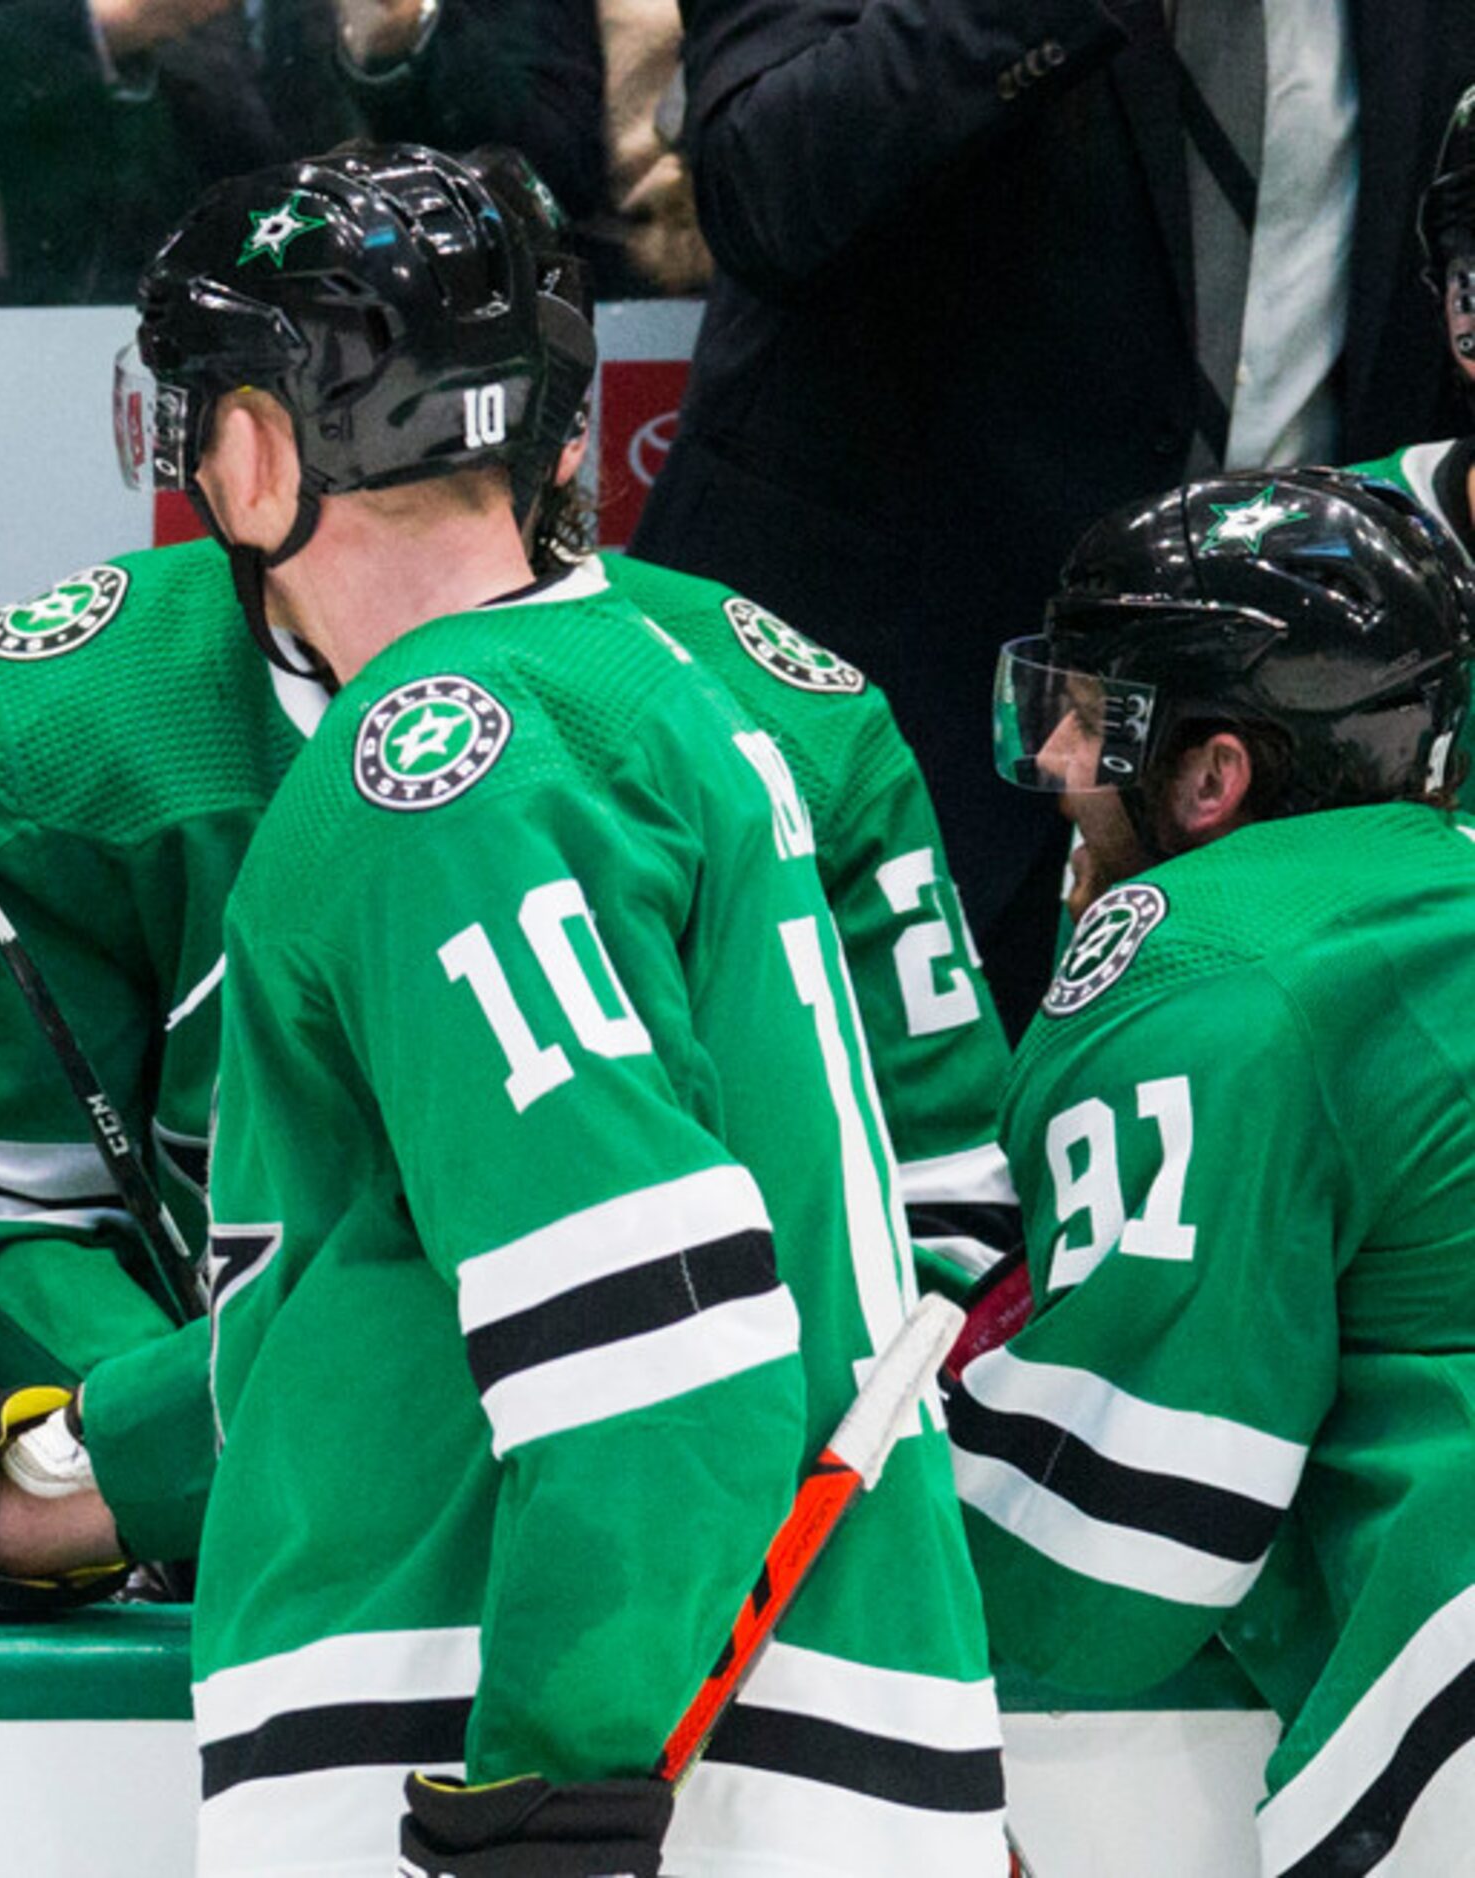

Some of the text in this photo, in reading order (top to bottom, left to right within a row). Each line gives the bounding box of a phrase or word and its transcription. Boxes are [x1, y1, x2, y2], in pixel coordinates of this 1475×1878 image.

[463, 383, 506, 450] 10
[362, 682, 496, 759] DALLAS
[375, 736, 496, 800] STARS
[876, 846, 983, 1037] 2
[436, 877, 654, 1116] 10
[87, 1093, 130, 1156] CCM
[1045, 1074, 1198, 1294] 91
